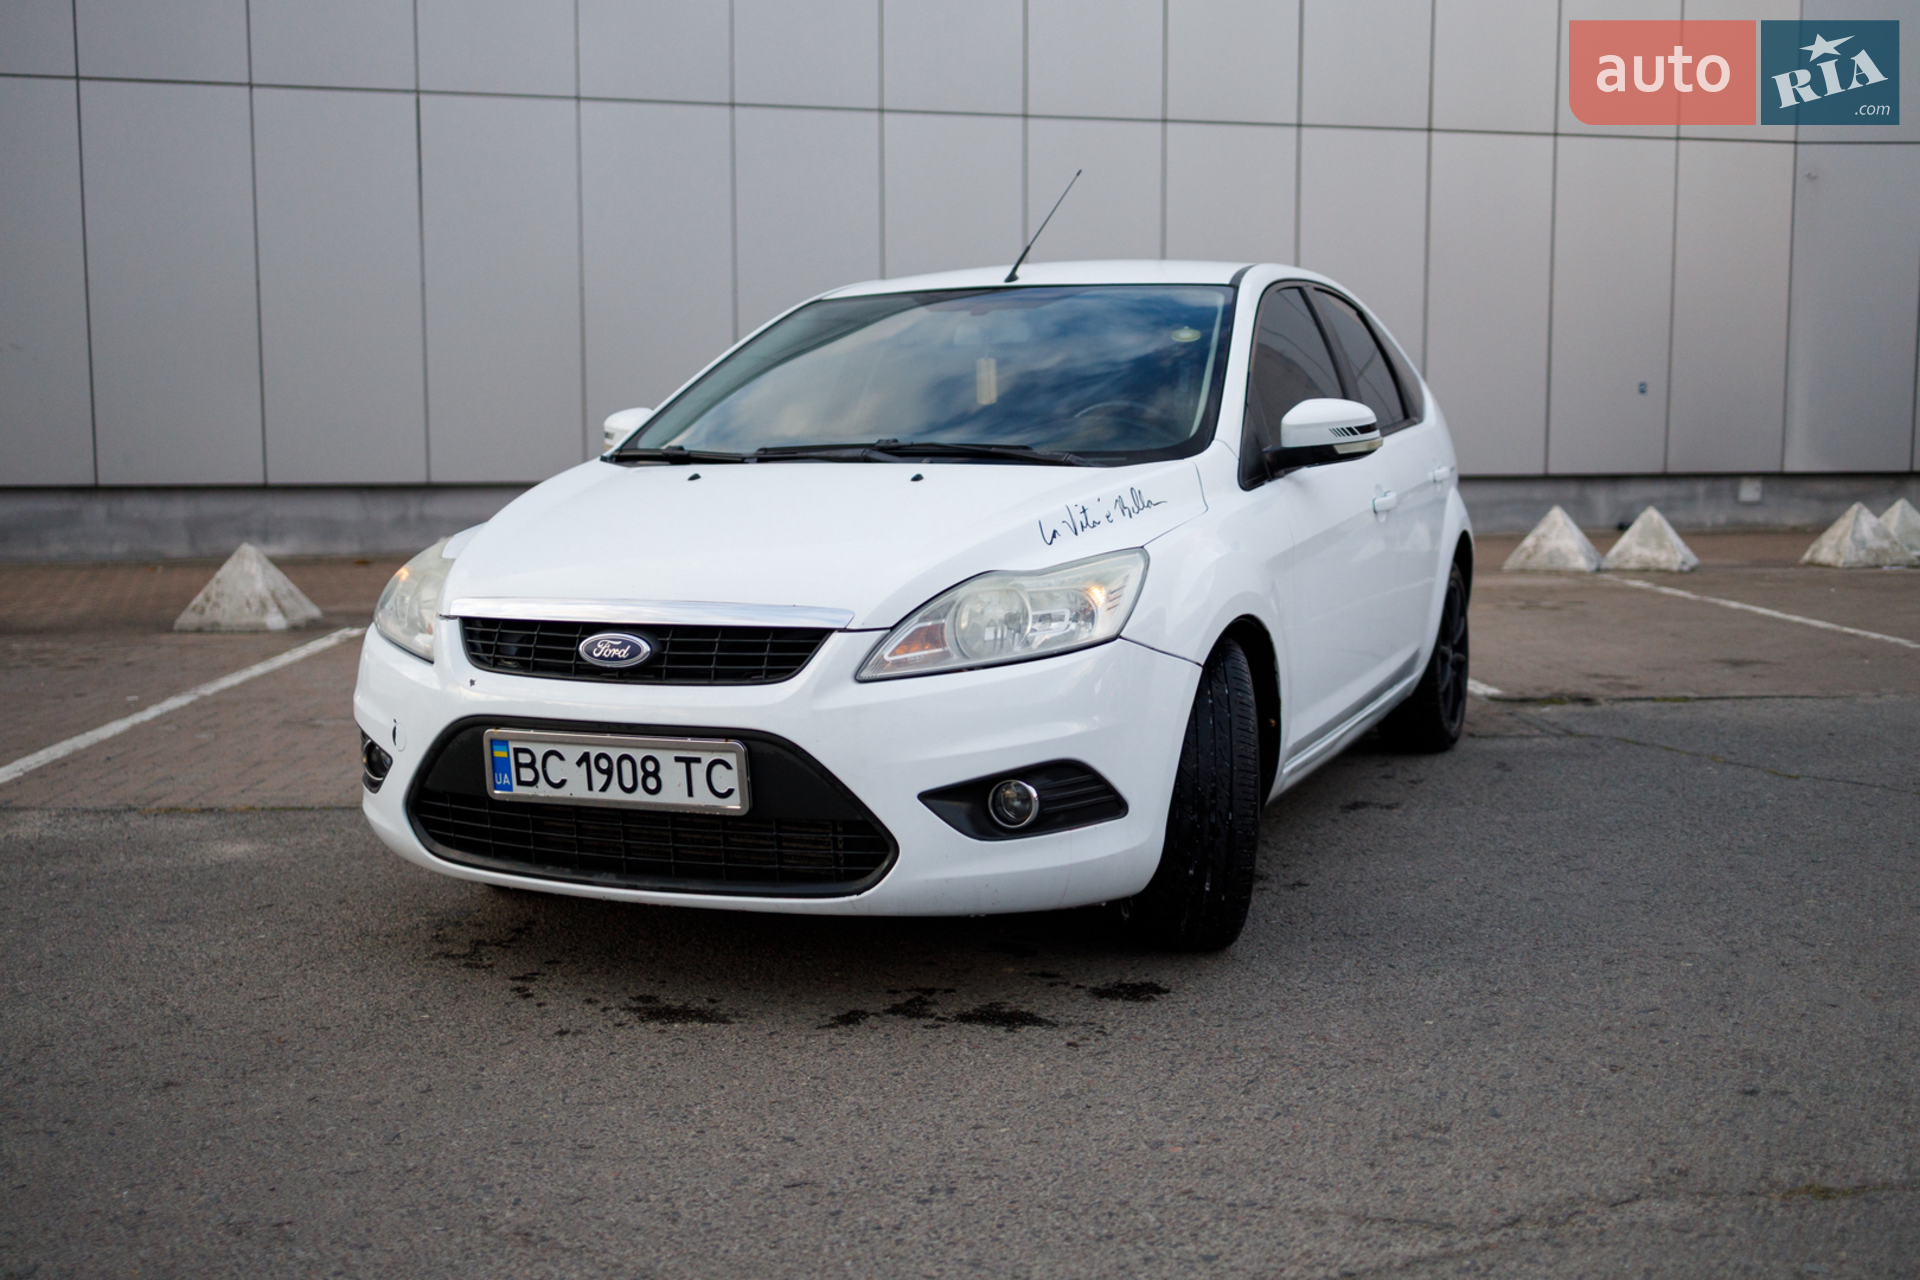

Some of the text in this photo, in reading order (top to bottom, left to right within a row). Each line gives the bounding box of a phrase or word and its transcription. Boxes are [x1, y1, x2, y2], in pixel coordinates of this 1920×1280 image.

[592, 639, 631, 659] Ford
[494, 772, 511, 786] UA
[512, 747, 736, 799] BC 1908 TC
